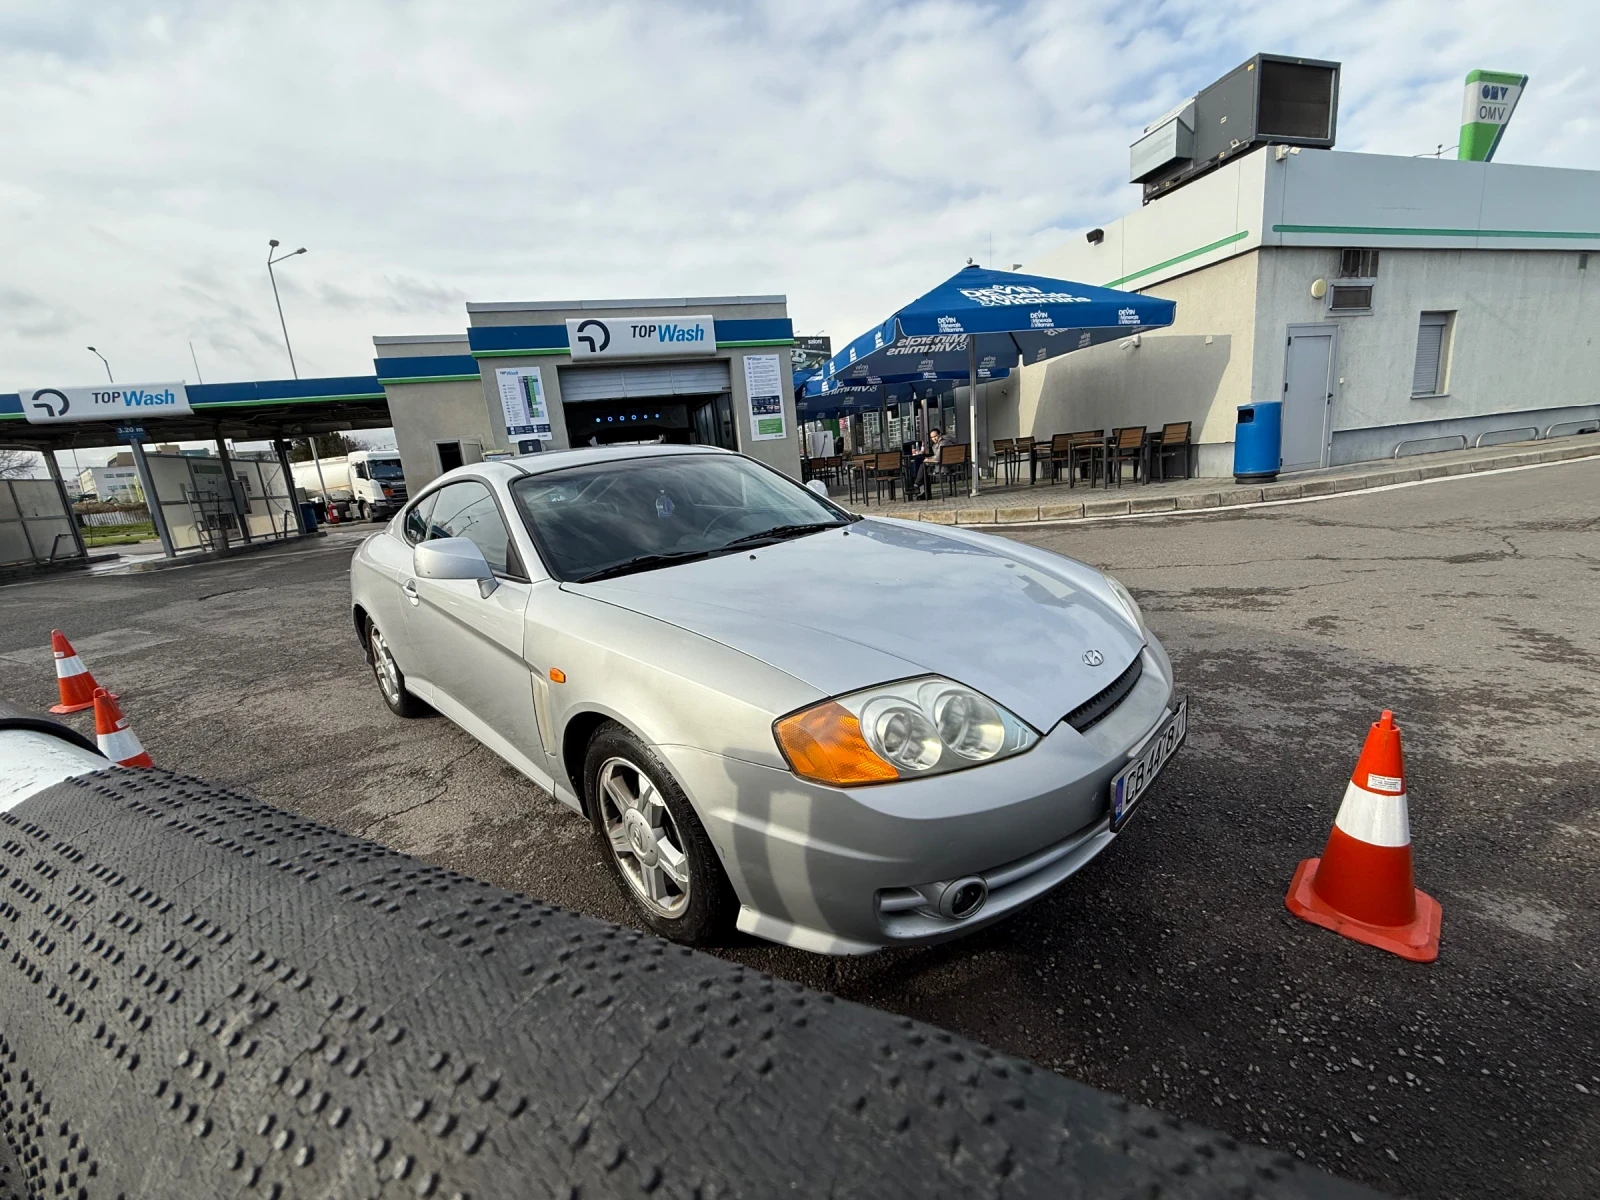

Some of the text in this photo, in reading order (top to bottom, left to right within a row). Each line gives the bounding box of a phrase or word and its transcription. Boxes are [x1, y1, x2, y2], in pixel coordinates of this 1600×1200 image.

[1479, 105, 1506, 121] OMV
[960, 285, 1043, 298] DEVIN
[937, 316, 956, 324] DEVIN
[630, 323, 704, 342] TOP Wash
[92, 389, 175, 407] TOP Wash
[1126, 761, 1145, 804] CB
